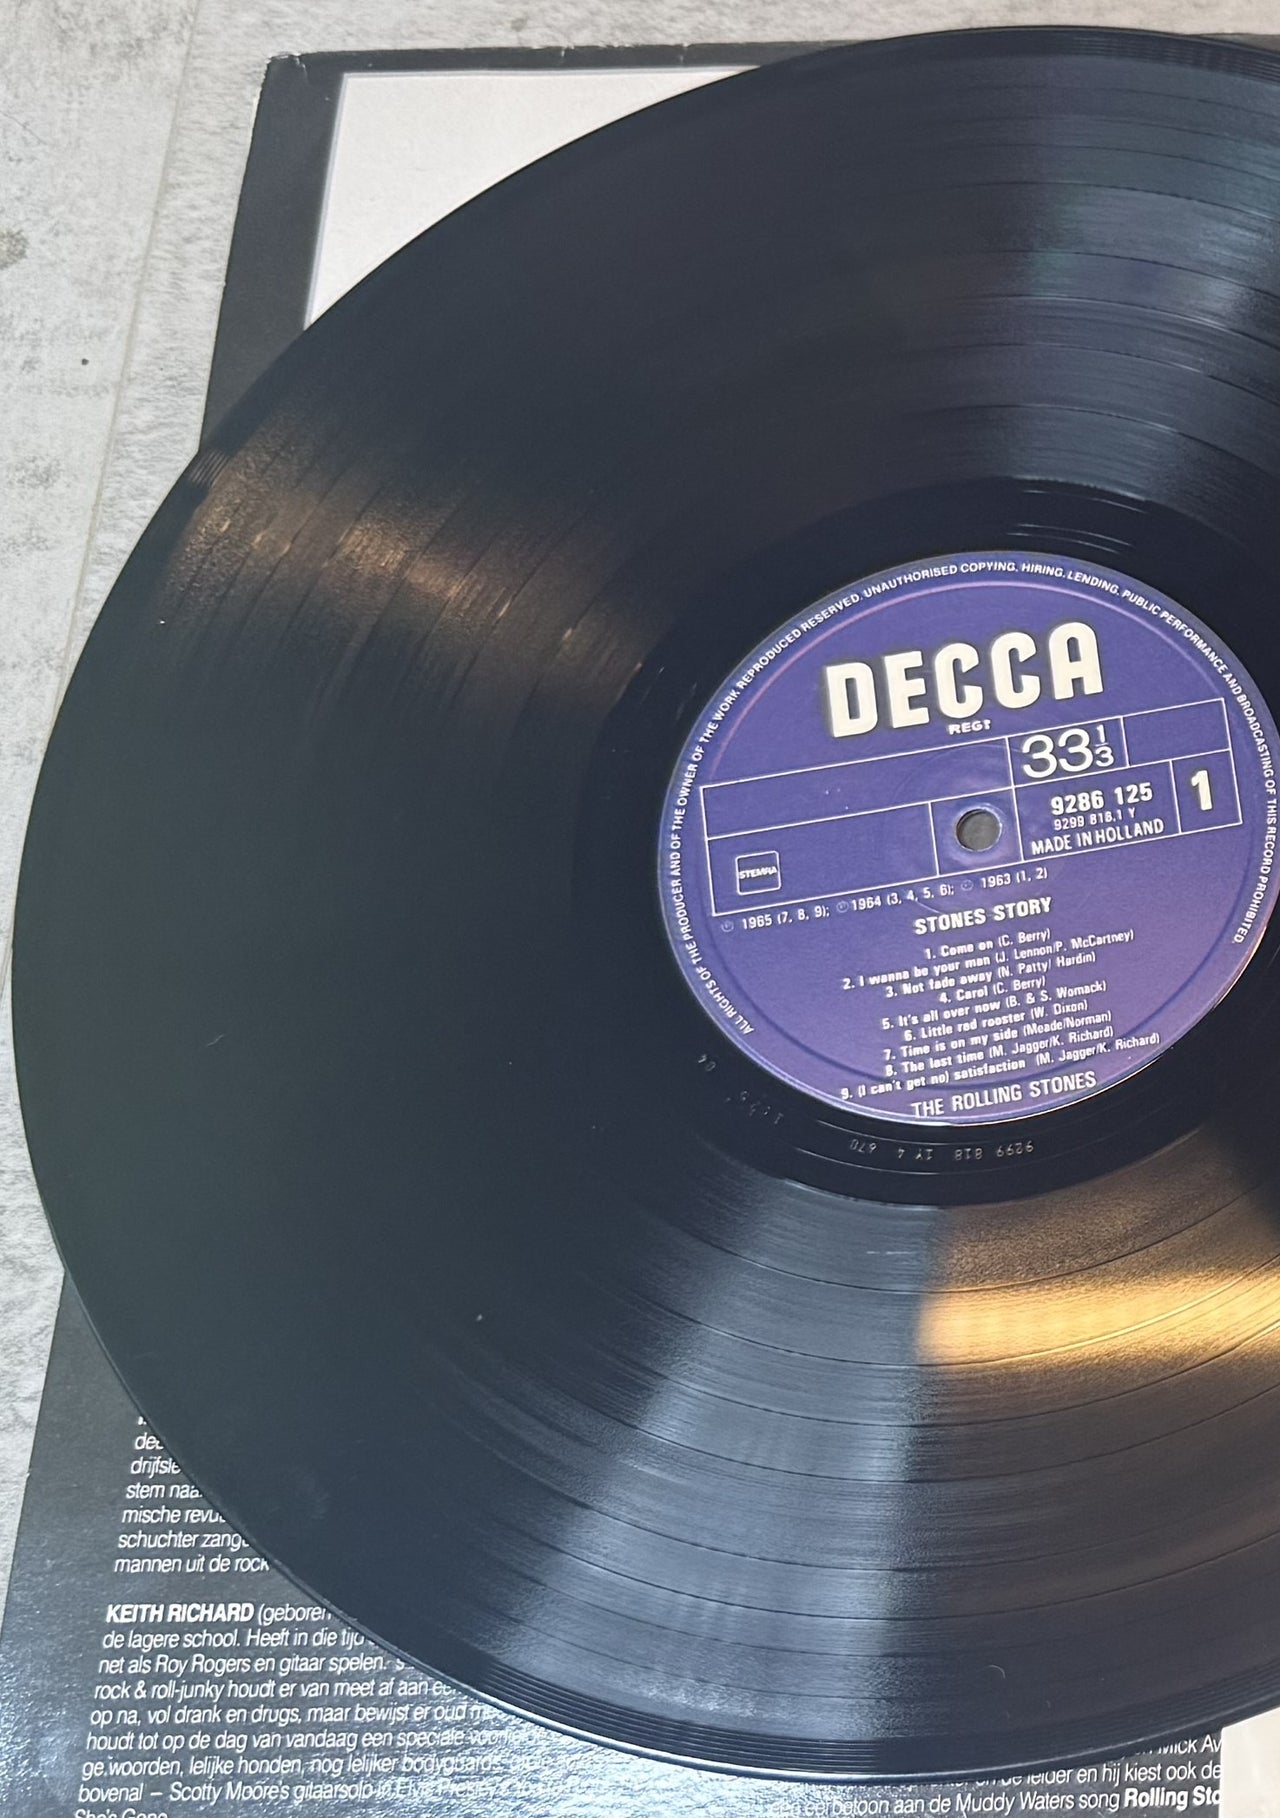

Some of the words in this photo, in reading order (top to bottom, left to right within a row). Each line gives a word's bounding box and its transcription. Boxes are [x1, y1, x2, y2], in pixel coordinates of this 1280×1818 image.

[863, 563, 958, 599] UNAUTHORISED
[826, 621, 1103, 738] DECCA
[1050, 789, 1105, 816] 9286
[1113, 781, 1153, 806] 125
[1191, 769, 1212, 811] 1
[1053, 815, 1085, 831] 9299
[1089, 808, 1123, 826] 818.1
[1127, 807, 1136, 819] Y
[1030, 834, 1073, 856] MADE
[1075, 831, 1093, 848] IN
[1094, 818, 1164, 844] HOLLAND
[914, 910, 986, 934] STONES
[991, 896, 1052, 922] STORY
[939, 943, 974, 958] Come
[977, 940, 994, 951] on
[1017, 927, 1051, 944] Berry)
[920, 1023, 953, 1039] Little
[957, 1018, 978, 1033] red
[981, 1012, 1026, 1028] rooster
[1052, 999, 1088, 1016] Dixon)
[910, 1099, 945, 1119] THE
[951, 1085, 1022, 1112] ROLLING
[1029, 1072, 1096, 1098] STONES
[106, 1604, 162, 1623] KEITH
[167, 1602, 254, 1623] RICHARD
[102, 1630, 125, 1649] de
[129, 1630, 179, 1652] lagere
[247, 1627, 289, 1646] Heeft
[292, 1631, 309, 1646] in
[313, 1627, 338, 1646] die
[98, 1656, 126, 1675] net
[127, 1655, 152, 1675] als
[154, 1654, 189, 1678] Roy
[190, 1654, 251, 1678] Rogers
[253, 1657, 276, 1673] en
[280, 1654, 324, 1676] gitaar
[930, 1795, 951, 1813] de
[956, 1792, 1015, 1816] Muddy
[1019, 1791, 1075, 1811] Waters
[1079, 1795, 1120, 1813] song
[1125, 1789, 1188, 1812] Rolling
